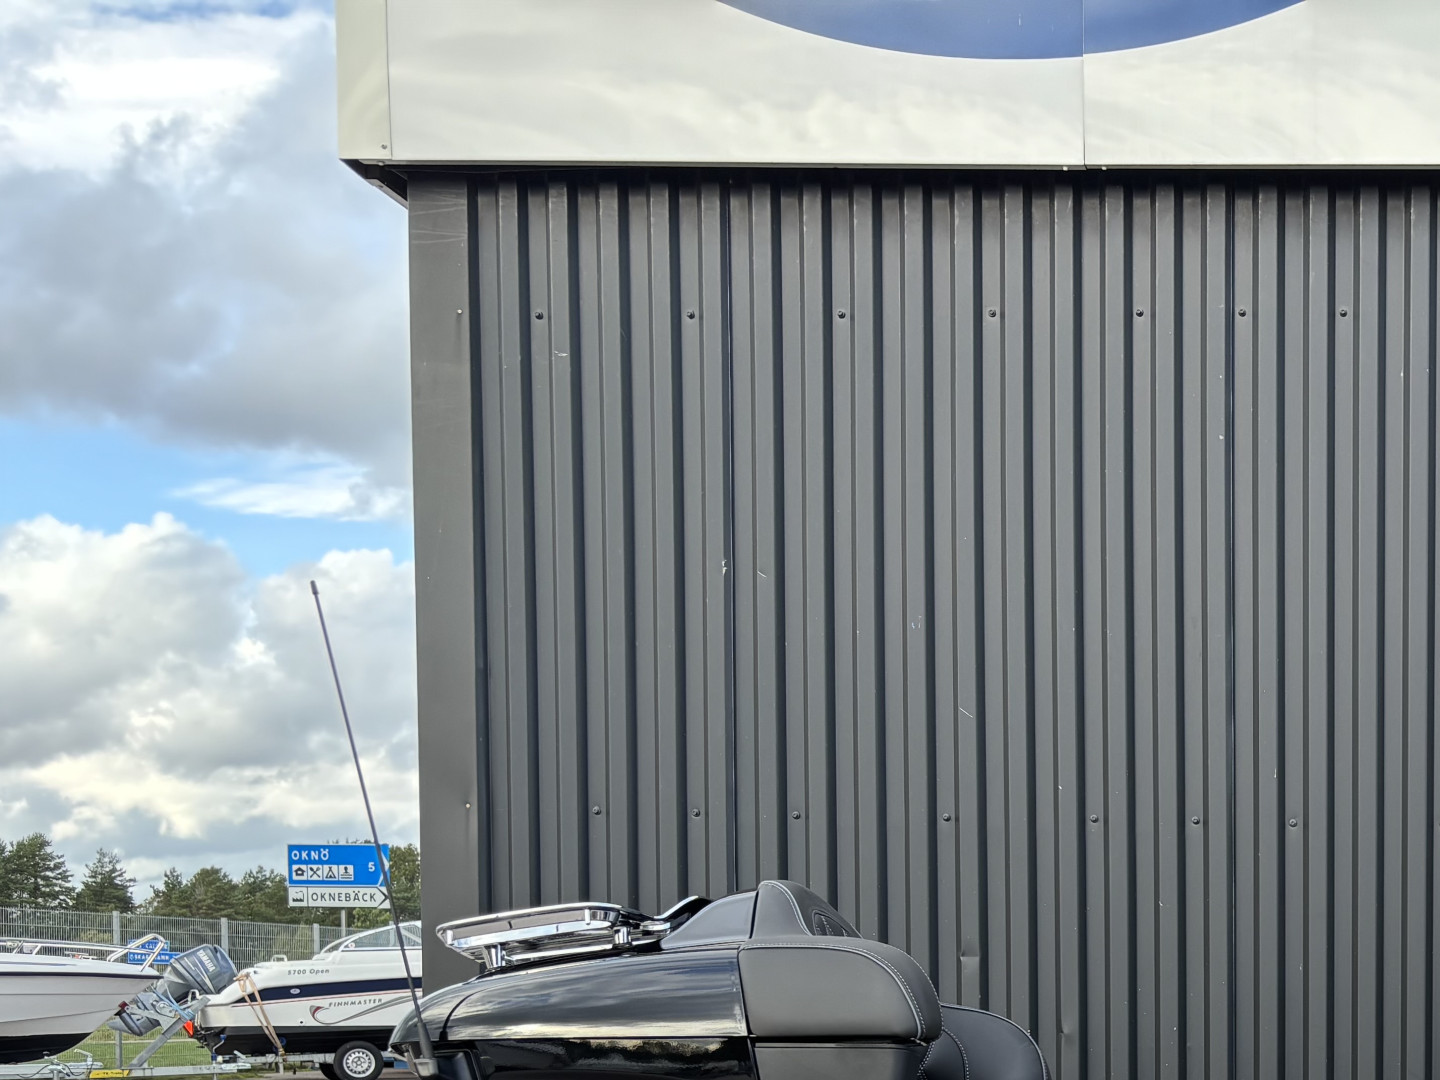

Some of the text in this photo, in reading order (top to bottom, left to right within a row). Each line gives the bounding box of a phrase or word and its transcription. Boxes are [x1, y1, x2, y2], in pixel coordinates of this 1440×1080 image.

[291, 848, 330, 861] OKNÖ
[368, 862, 376, 872] 5
[311, 890, 377, 902] OKNEBÄCK
[196, 949, 216, 972] YAMAHA
[287, 968, 330, 976] 5700 Open
[328, 998, 383, 1008] FINNMASTER
